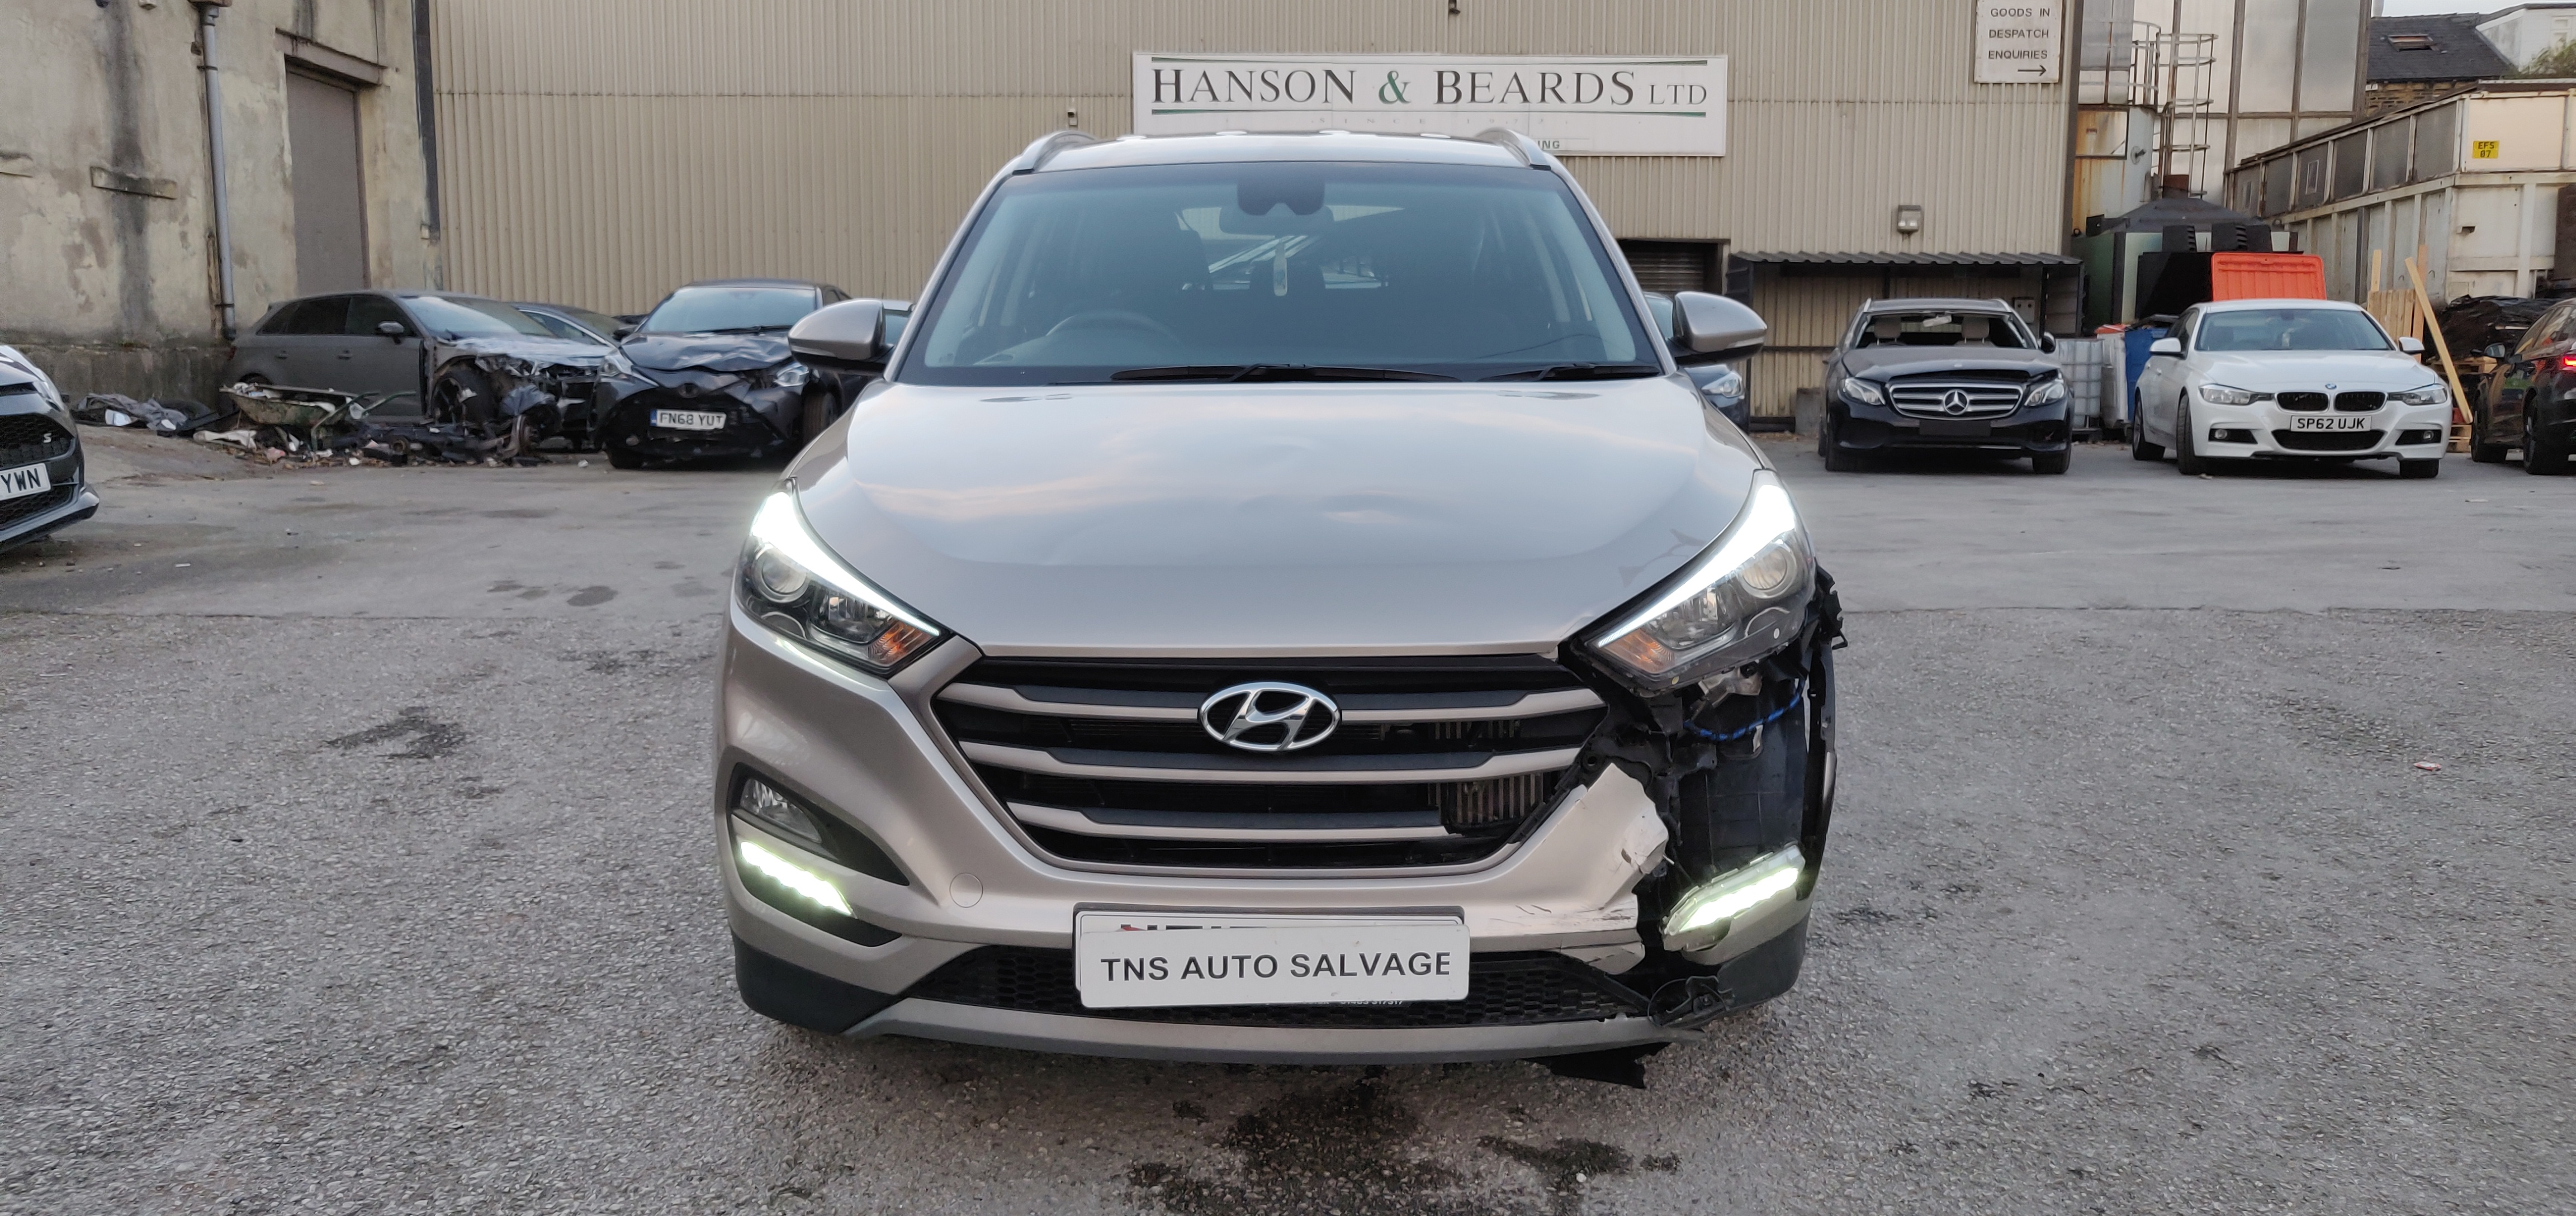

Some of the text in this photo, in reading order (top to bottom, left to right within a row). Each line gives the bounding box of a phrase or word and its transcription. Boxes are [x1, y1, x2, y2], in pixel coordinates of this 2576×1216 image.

[1990, 8, 2050, 17] GOODS IN
[1989, 29, 2049, 39] DESPATCH
[1988, 50, 2048, 59] ENQUIRIES
[1152, 69, 1707, 105] HANSON & BEARDS LTD
[699, 414, 723, 426] YUT
[2297, 417, 2365, 429] SP62 UJK
[0, 468, 41, 493] YWN
[1100, 951, 1451, 981] TNS AUTO SALVAGE
